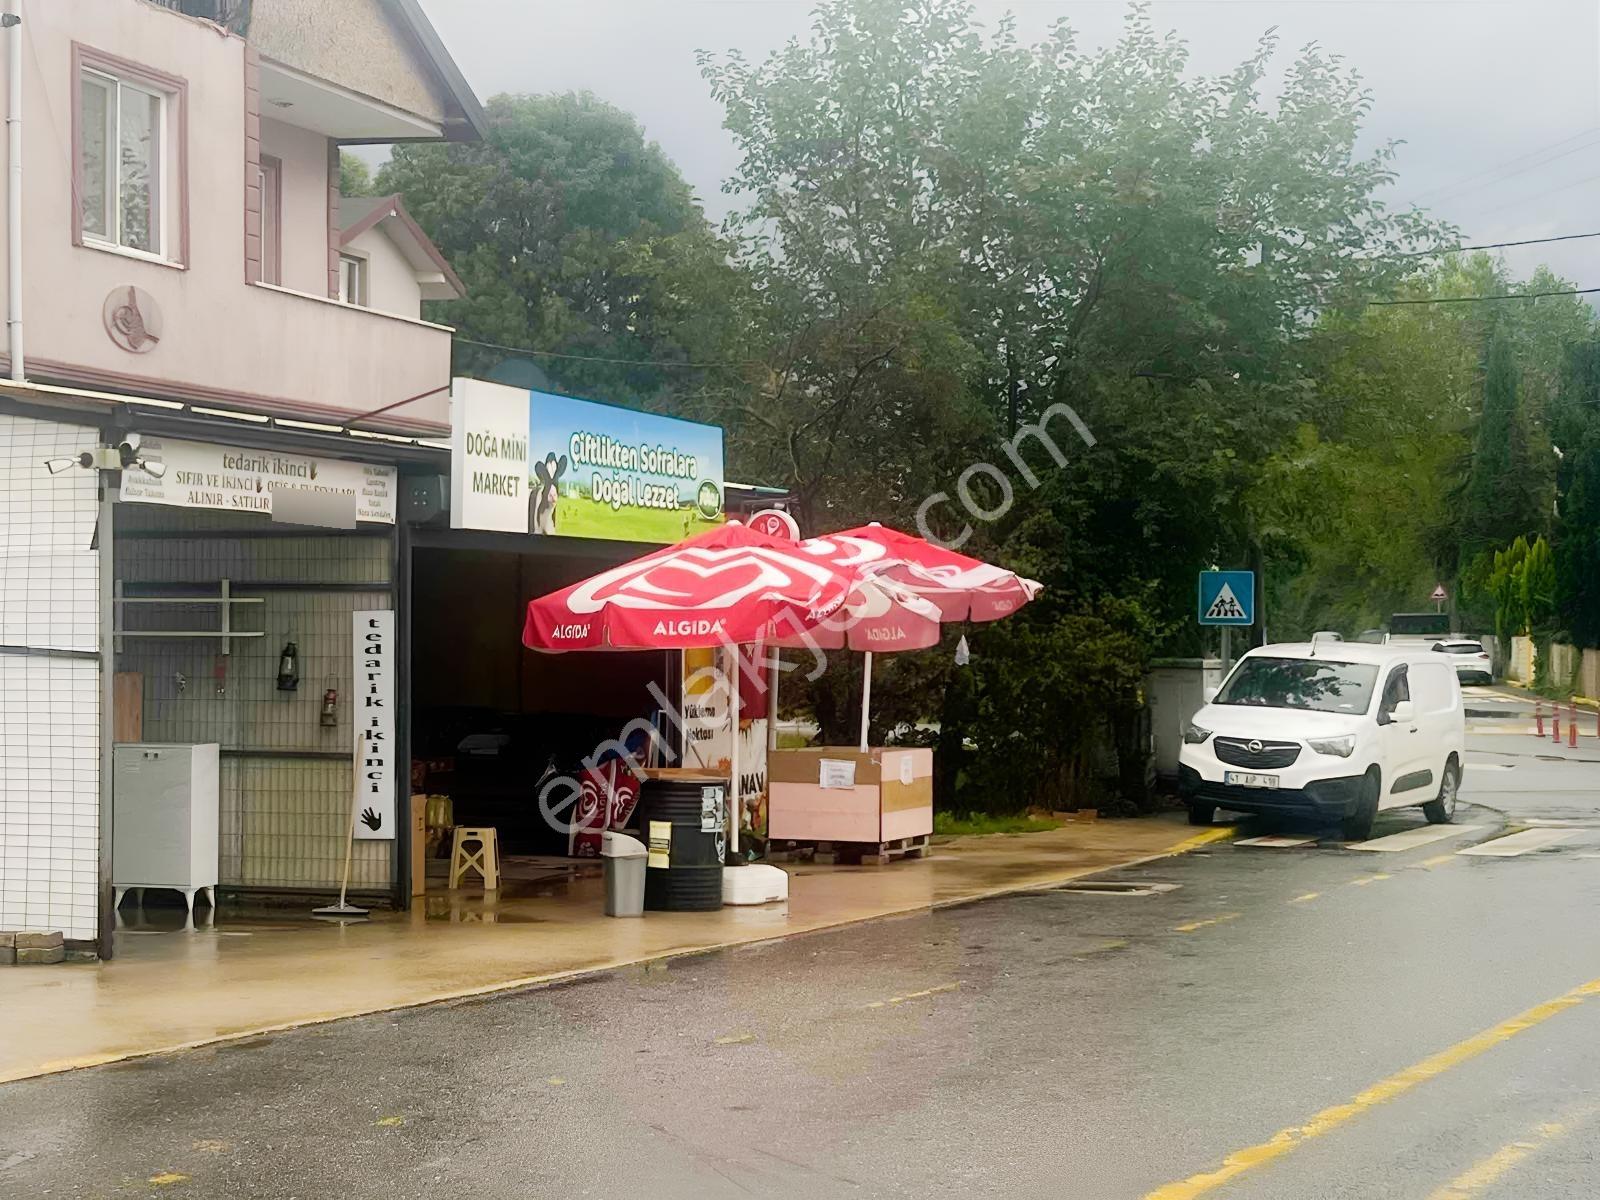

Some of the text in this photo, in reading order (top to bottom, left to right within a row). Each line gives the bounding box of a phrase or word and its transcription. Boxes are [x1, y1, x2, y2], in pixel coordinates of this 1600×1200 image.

[466, 430, 527, 462] DOĞA MİNİ
[569, 431, 698, 482] Çiftlikten Sofralara
[223, 451, 307, 479] tedarik ikinci
[206, 473, 219, 487] VE
[472, 471, 520, 497] MARKET
[592, 471, 635, 510] Doğal
[635, 480, 680, 509] Lezzet
[187, 491, 223, 506] ALINIR
[231, 495, 270, 510] SATILIR
[552, 624, 589, 639] ALGIDA
[653, 620, 725, 637] ALGIDA
[365, 618, 385, 793] tedarik ikinci
